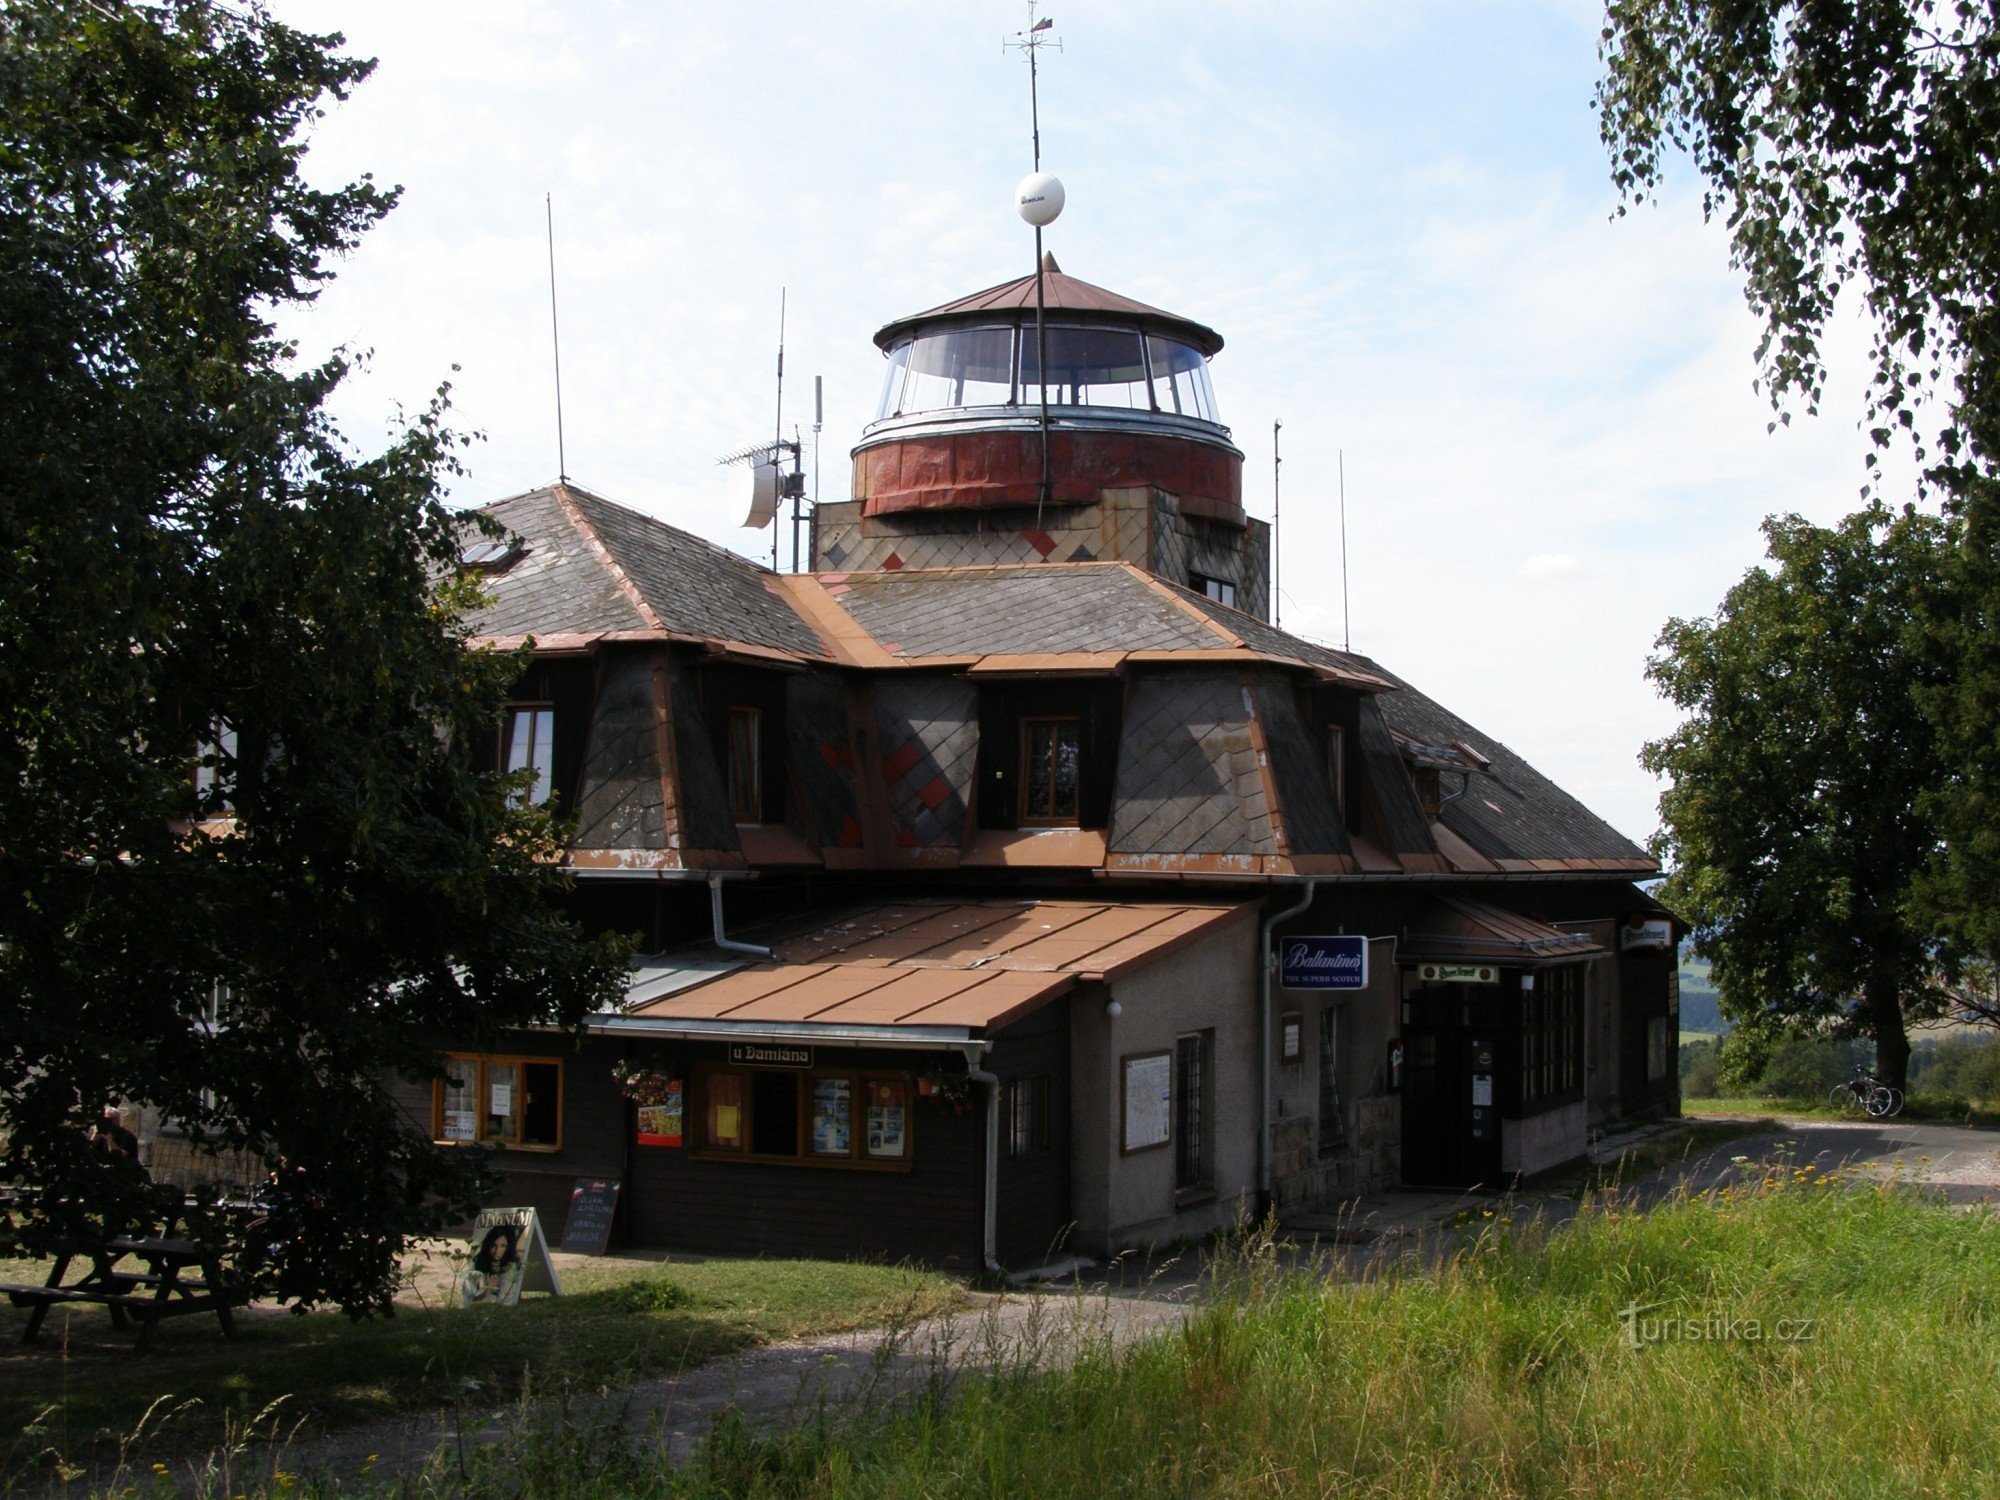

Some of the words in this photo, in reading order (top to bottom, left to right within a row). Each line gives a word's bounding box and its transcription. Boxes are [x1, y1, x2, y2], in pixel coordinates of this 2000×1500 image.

[1285, 975, 1300, 983] THE
[1302, 975, 1331, 983] SUPERB
[1332, 975, 1361, 983] SCOTCH
[733, 1048, 742, 1059] u
[745, 1045, 809, 1062] Damiána
[477, 1210, 532, 1228] MAGNUM
